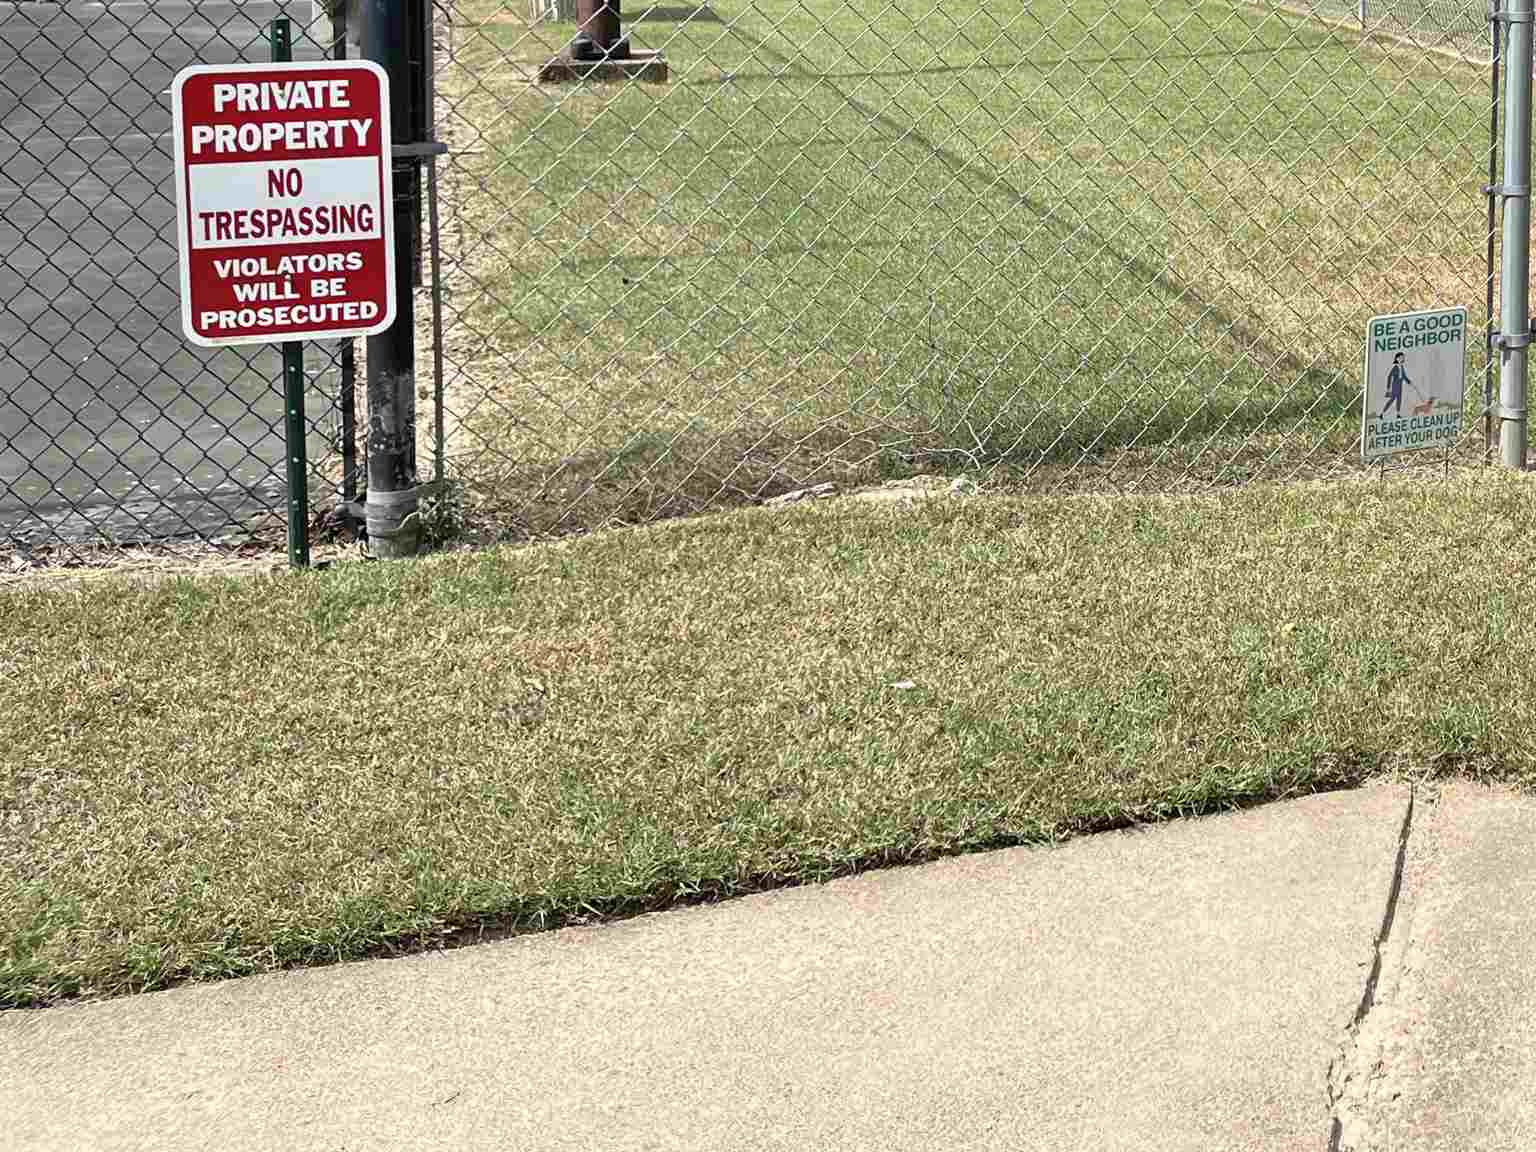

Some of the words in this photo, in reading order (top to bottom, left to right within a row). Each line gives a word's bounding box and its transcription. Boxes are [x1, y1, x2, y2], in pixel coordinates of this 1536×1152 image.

[213, 80, 350, 112] PRIVATE
[192, 118, 372, 153] PROPERTY
[267, 168, 303, 197] NO
[199, 204, 373, 240] TRESPASSING
[214, 252, 363, 278] VIOLATORS
[232, 282, 300, 302] WILL
[311, 279, 346, 298] BE
[200, 301, 378, 330] PROSECUTED
[1374, 322, 1395, 336] BE
[1400, 320, 1410, 333] A
[1414, 314, 1463, 331] GOOD
[1375, 329, 1461, 352] NEIGHBOR
[1368, 420, 1408, 435] PLEASE
[1410, 415, 1443, 429] CLEAN
[1446, 412, 1459, 424] UP
[1369, 434, 1402, 448] AFTER
[1404, 431, 1433, 444] YOUR
[1435, 426, 1457, 439] DOG
